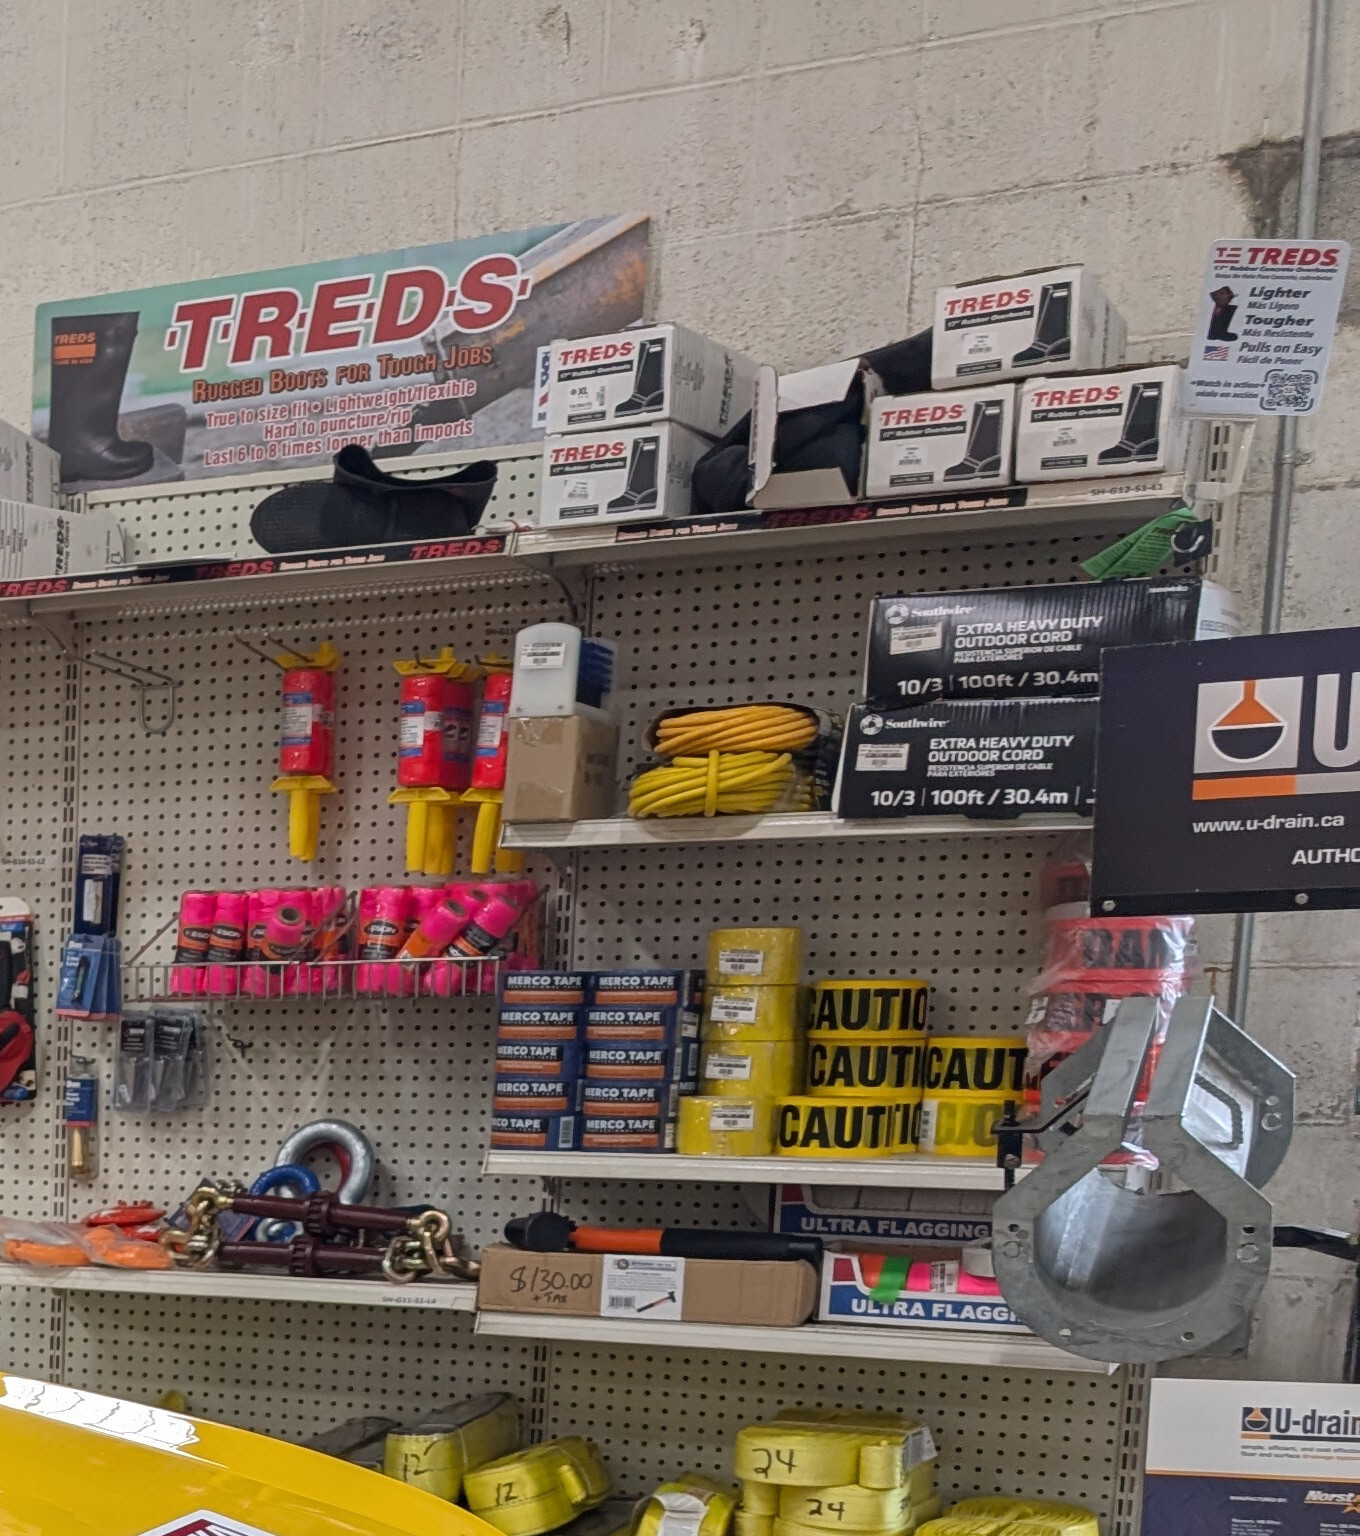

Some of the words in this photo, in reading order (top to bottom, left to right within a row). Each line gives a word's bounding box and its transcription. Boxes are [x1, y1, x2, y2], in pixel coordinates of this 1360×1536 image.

[1247, 247, 1340, 267] TREDS
[944, 288, 1034, 316] TREDS
[1249, 286, 1312, 301] Lighter
[168, 253, 530, 372] TREDS
[1245, 314, 1315, 328] Tougher
[557, 341, 636, 367] TREDS
[1238, 341, 1271, 353] Pulls
[1273, 344, 1291, 353] on
[1293, 343, 1324, 357] Easy
[1032, 386, 1123, 408] TREDS
[206, 411, 237, 429] True
[240, 409, 255, 425] to
[257, 405, 288, 423] size
[290, 401, 309, 420] fit
[879, 404, 967, 427] TREDS
[264, 420, 297, 441] Hard
[302, 419, 315, 436] to
[203, 448, 235, 467] Last
[237, 445, 246, 462] 6
[250, 445, 265, 461] to
[269, 441, 278, 459] 8
[281, 437, 322, 458] times
[377, 430, 410, 448] than
[415, 420, 475, 445] imports
[549, 441, 627, 463] TREDS
[412, 538, 502, 559] TREDS
[910, 604, 976, 617] Southwire
[955, 624, 1003, 637] EXTRA
[1006, 620, 1058, 634] HEAVY
[1060, 616, 1104, 630] DUTY
[954, 634, 1028, 649] OUTDOOR
[1030, 631, 1073, 644] CORD
[897, 677, 944, 696] 10/3
[958, 674, 1014, 690] 100ft
[1033, 670, 1099, 686] 30.4m
[884, 719, 951, 730] Southwire
[929, 738, 977, 750] EXTRA
[979, 736, 1030, 749] HEAVY
[1031, 735, 1075, 748] DUTY
[928, 750, 1000, 763] OUTDOOR
[1002, 749, 1044, 761] CORD
[870, 790, 916, 806] 10/3
[931, 788, 985, 805] 100ft
[1003, 788, 1068, 805] 30.4m
[1192, 812, 1345, 833] www.u-drain.ca
[507, 975, 552, 986] MERCO
[554, 975, 582, 986] TAPE
[599, 975, 641, 986] MERCO
[642, 975, 675, 987] TAPE
[501, 1011, 541, 1022] MERCO
[542, 1011, 575, 1022] TAPE
[627, 1011, 661, 1022] TAPE
[529, 1046, 559, 1057] TAPE
[628, 1051, 662, 1062] TAPE
[531, 1082, 564, 1094] TAPE
[621, 1087, 655, 1098] TAPE
[510, 1118, 542, 1129] TAPE
[586, 1119, 626, 1130] MERCO
[627, 1119, 655, 1130] TAPE
[800, 1216, 872, 1234] ULTRA
[876, 1220, 990, 1239] FLAGGING
[509, 1265, 594, 1292] $130.00
[851, 1298, 926, 1318] ULTRA
[751, 1447, 799, 1479] 24
[806, 1498, 845, 1521] 24
